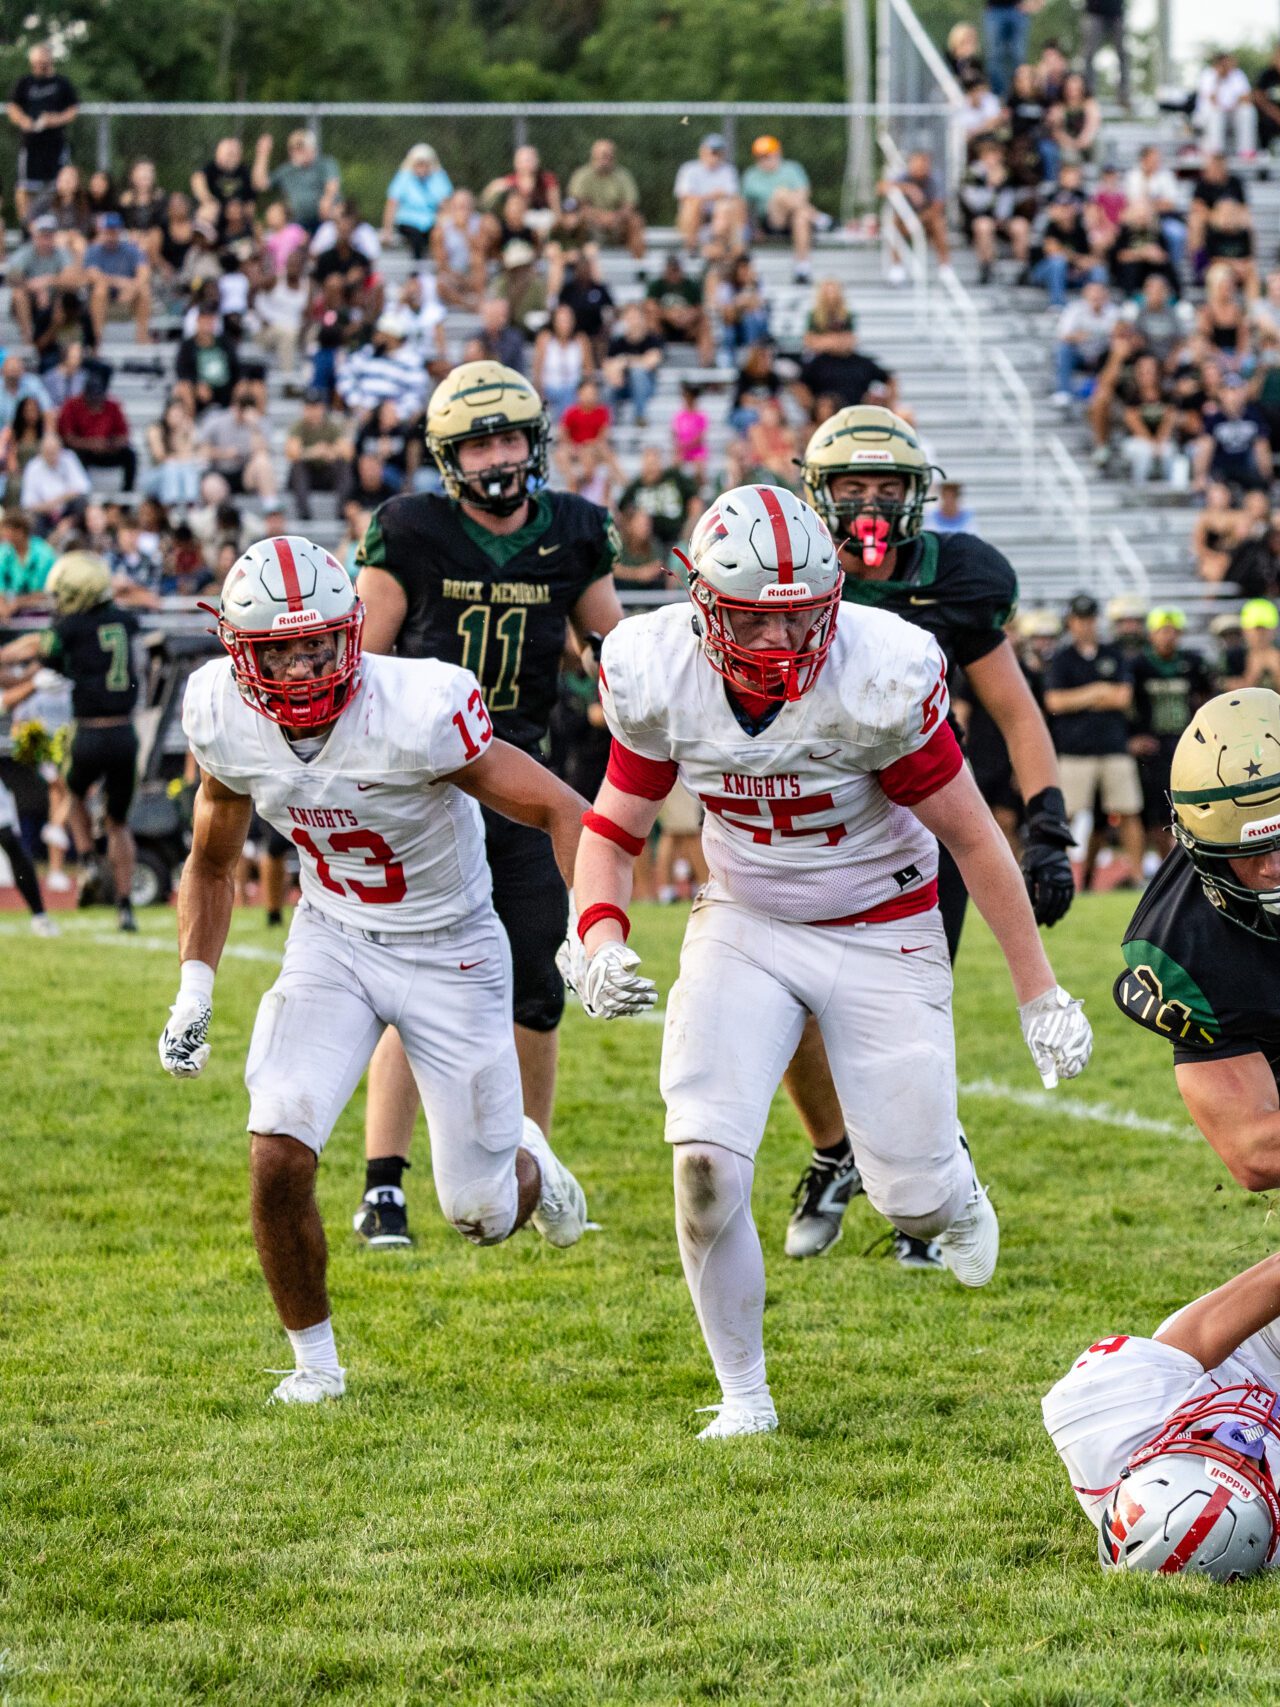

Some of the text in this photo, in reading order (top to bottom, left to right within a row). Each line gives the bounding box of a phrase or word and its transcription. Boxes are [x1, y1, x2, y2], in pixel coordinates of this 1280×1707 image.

[442, 578, 484, 601] BRICK
[768, 587, 807, 598] Riddell
[278, 612, 318, 626] Riddell
[97, 622, 130, 692] 7
[457, 604, 527, 712] 11
[452, 688, 494, 762] 13
[721, 771, 801, 799] KNIGHTS
[287, 805, 359, 829] KNIGHTS
[291, 827, 408, 904] 13
[1240, 1423, 1266, 1443] TRND
[1209, 1467, 1252, 1499] Riddell
